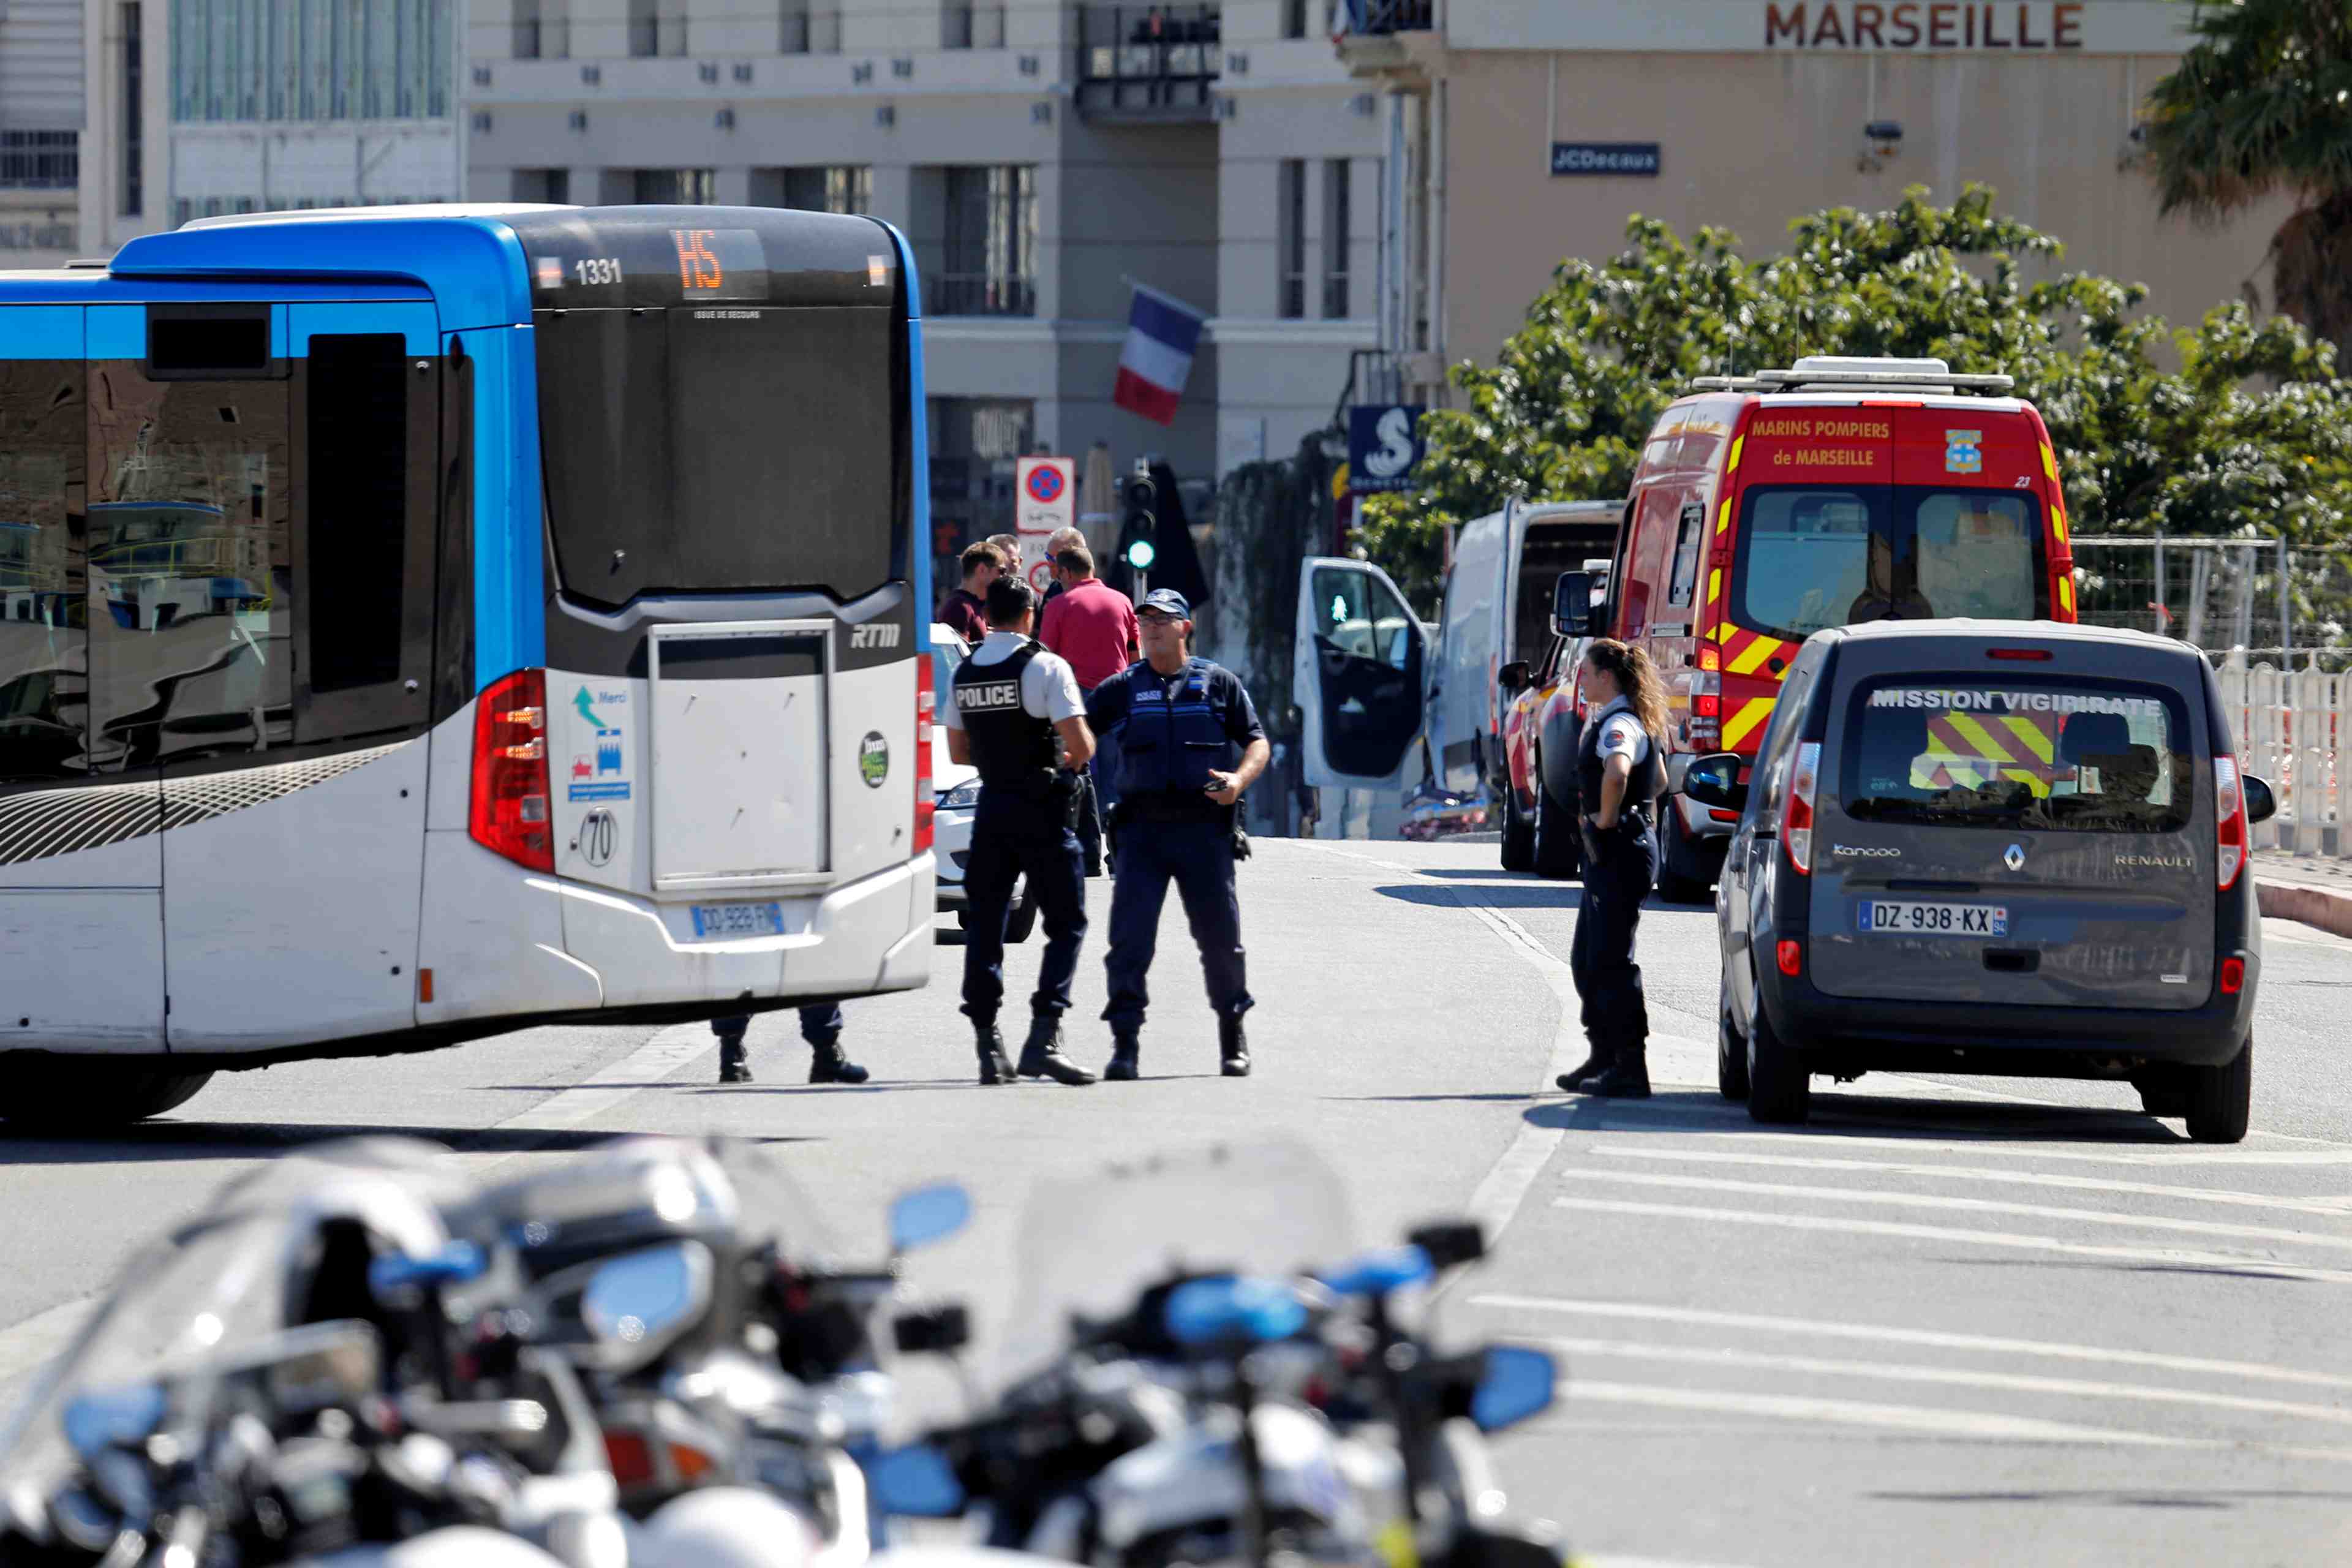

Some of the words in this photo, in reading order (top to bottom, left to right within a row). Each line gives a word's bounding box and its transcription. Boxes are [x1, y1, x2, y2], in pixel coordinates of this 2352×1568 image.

[1766, 4, 2084, 47] MARSEILLE
[1555, 149, 1654, 169] JCDecaux
[676, 230, 723, 288] HS
[576, 258, 622, 285] 1331
[1752, 421, 1811, 436] MARINS
[1815, 421, 1889, 439] POMPIERS
[1774, 450, 1792, 465] de
[1795, 450, 1874, 466] MARSEILLE
[2015, 476, 2030, 488] 23
[851, 624, 900, 648] RTM
[599, 691, 627, 703] Merci
[956, 685, 1016, 707] POLICE
[1873, 690, 1992, 709] MISSION
[2000, 692, 2162, 716] VIGIPIRATE
[588, 814, 610, 860] 70
[2116, 855, 2192, 867] RENAULT
[1875, 905, 1989, 932] DZ-938-KX
